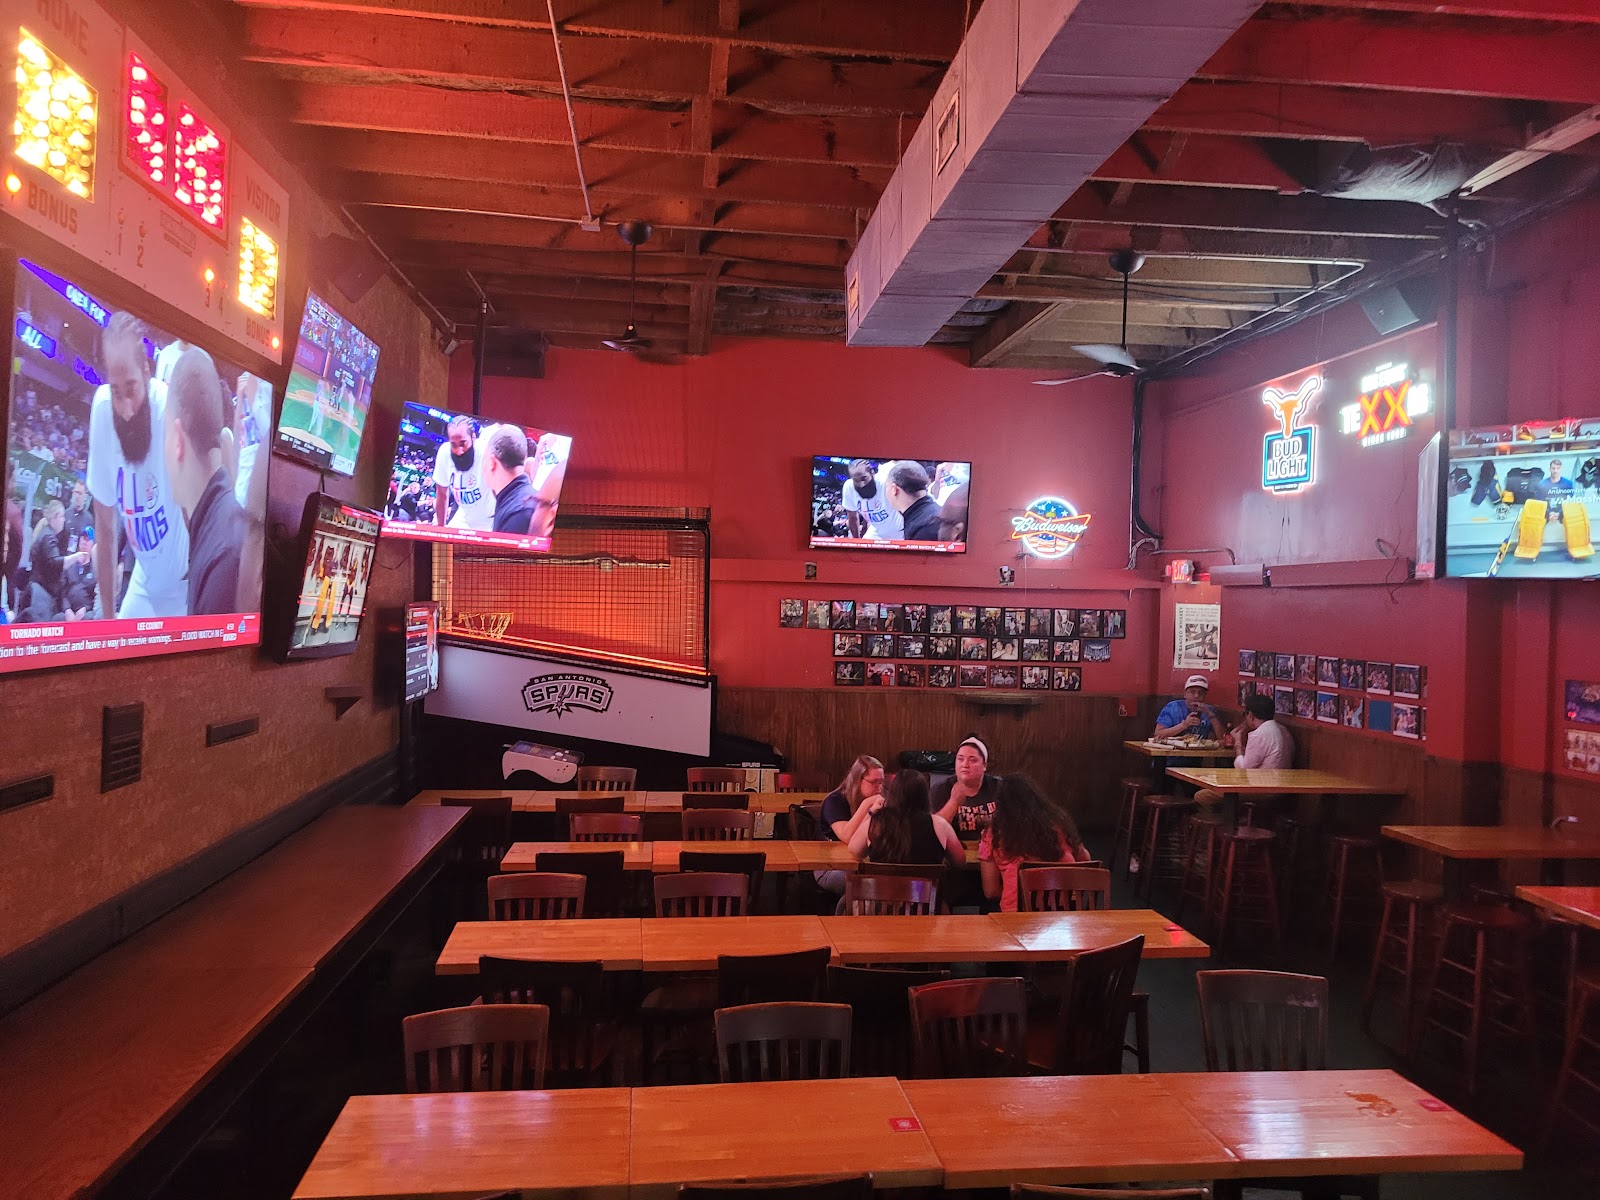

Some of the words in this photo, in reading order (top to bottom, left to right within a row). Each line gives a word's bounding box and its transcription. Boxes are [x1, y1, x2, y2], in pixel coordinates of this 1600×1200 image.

[28, 181, 78, 234] BONUS
[246, 175, 280, 227] VISITOR
[136, 244, 145, 269] 2
[205, 287, 211, 309] 3
[246, 317, 271, 347] BONUS
[1340, 380, 1430, 439] TEXX
[1273, 439, 1301, 458] BUD
[1268, 458, 1307, 478] LIGHT
[1011, 516, 1088, 534] Budweiser
[10, 627, 41, 640] TORNADO
[42, 626, 64, 638] WATCH
[137, 622, 146, 631] LEE
[145, 621, 164, 631] COUNTY
[16, 646, 24, 657] to
[26, 644, 39, 655] the
[41, 641, 70, 654] forecast
[71, 640, 85, 651] and
[86, 640, 101, 650] have
[107, 640, 119, 650] way
[198, 630, 215, 640] WATCH
[533, 675, 554, 684] SAN
[558, 674, 602, 685] ANTONIO
[530, 684, 605, 705] SPURS
